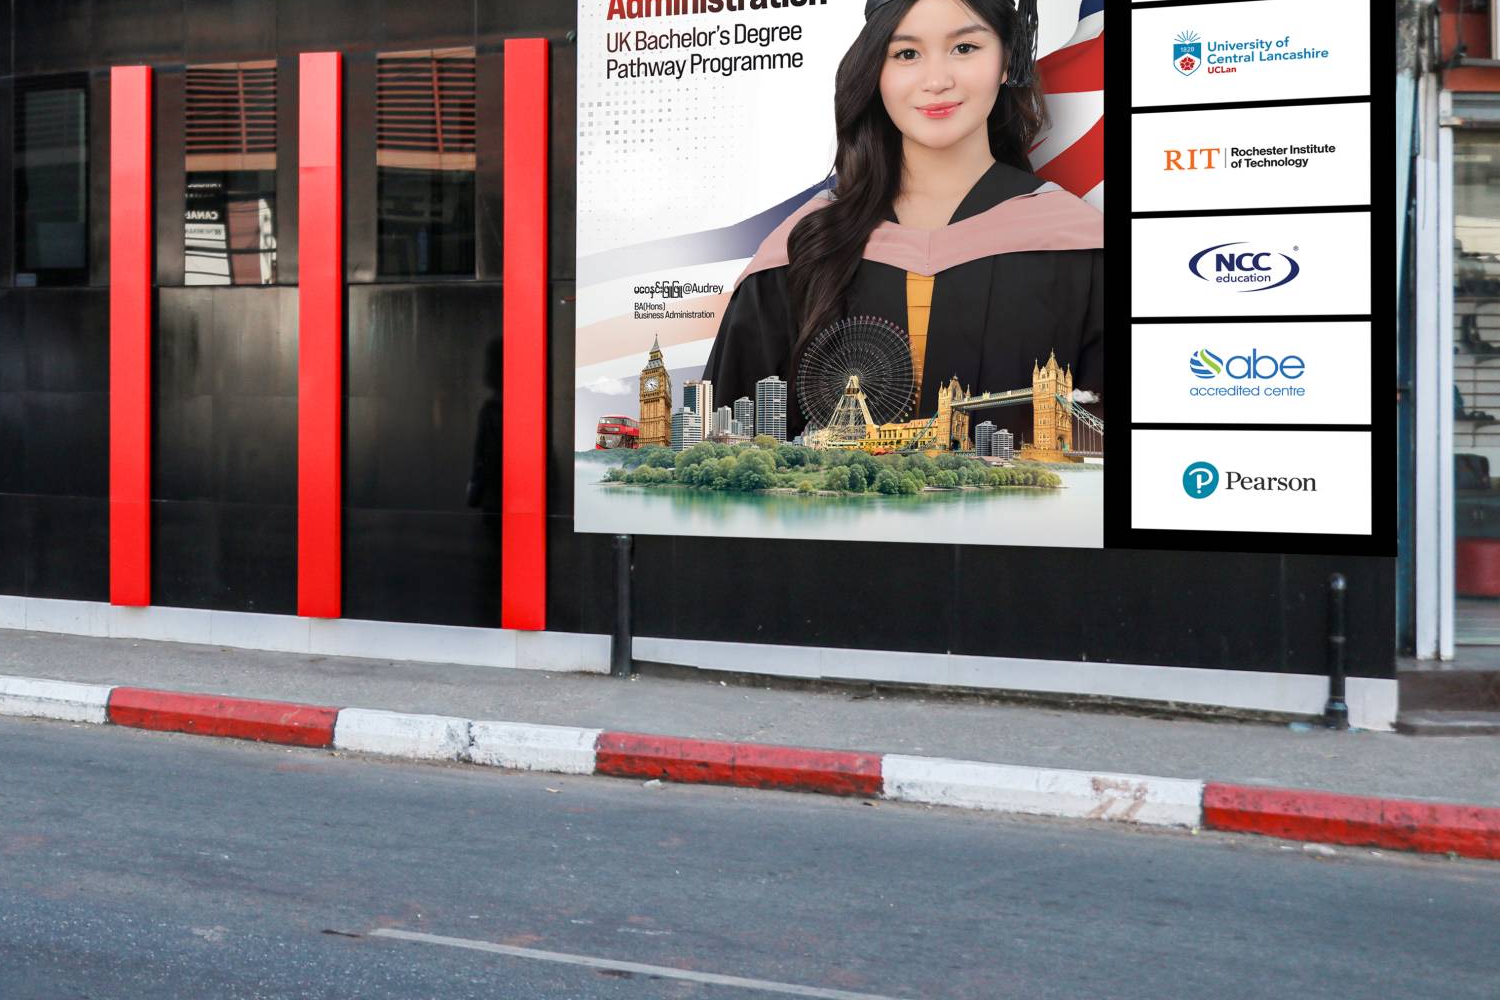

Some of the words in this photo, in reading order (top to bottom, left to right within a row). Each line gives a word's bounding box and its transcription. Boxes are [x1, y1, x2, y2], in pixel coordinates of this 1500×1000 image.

[606, 31, 632, 53] UK
[734, 23, 803, 47] Degree
[1207, 39, 1273, 53] University
[1276, 36, 1290, 48] of
[1207, 51, 1255, 65] Central
[1259, 48, 1329, 62] Lancashire
[606, 57, 687, 80] Pathway
[690, 51, 804, 77] Programme
[1207, 65, 1237, 75] UCLan
[1164, 147, 1220, 171] RIT
[1230, 147, 1288, 157] Rochester
[1289, 144, 1336, 155] Institute
[1230, 158, 1242, 168] of
[1244, 157, 1309, 168] Technology
[1215, 252, 1272, 272] NCC
[1215, 273, 1271, 283] education
[634, 302, 666, 311] BA(Hons)
[634, 311, 664, 320] Business
[665, 310, 715, 319] Administration
[1226, 348, 1306, 380] abe
[1190, 385, 1260, 397] accredited
[1264, 386, 1306, 397] centre
[1225, 471, 1317, 492] Pearson
